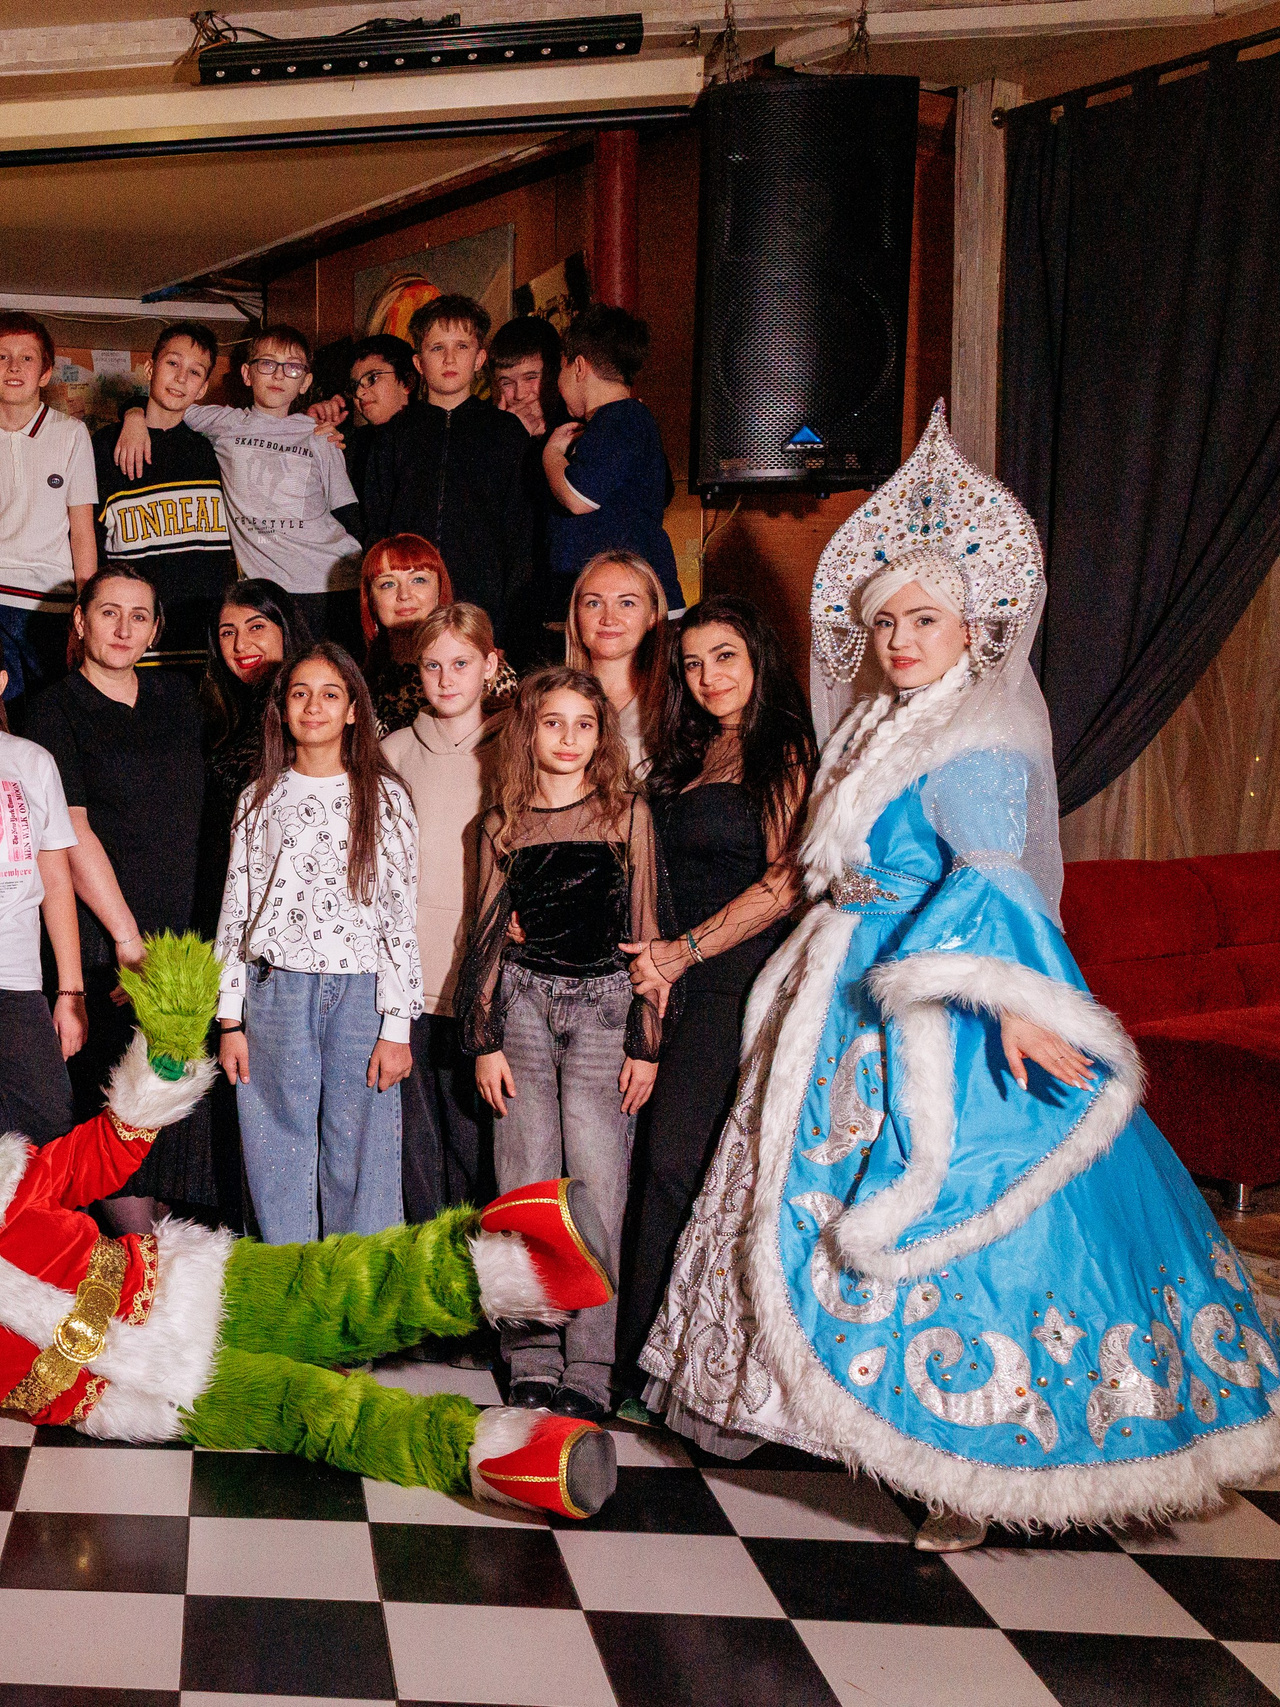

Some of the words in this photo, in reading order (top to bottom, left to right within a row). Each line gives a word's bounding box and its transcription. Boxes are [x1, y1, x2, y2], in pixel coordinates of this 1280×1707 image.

[118, 496, 227, 543] UNREAL
[11, 781, 24, 801] MOON
[9, 808, 18, 823] York
[17, 802, 26, 814] ON
[20, 816, 30, 840] WALK
[23, 842, 32, 860] MEN
